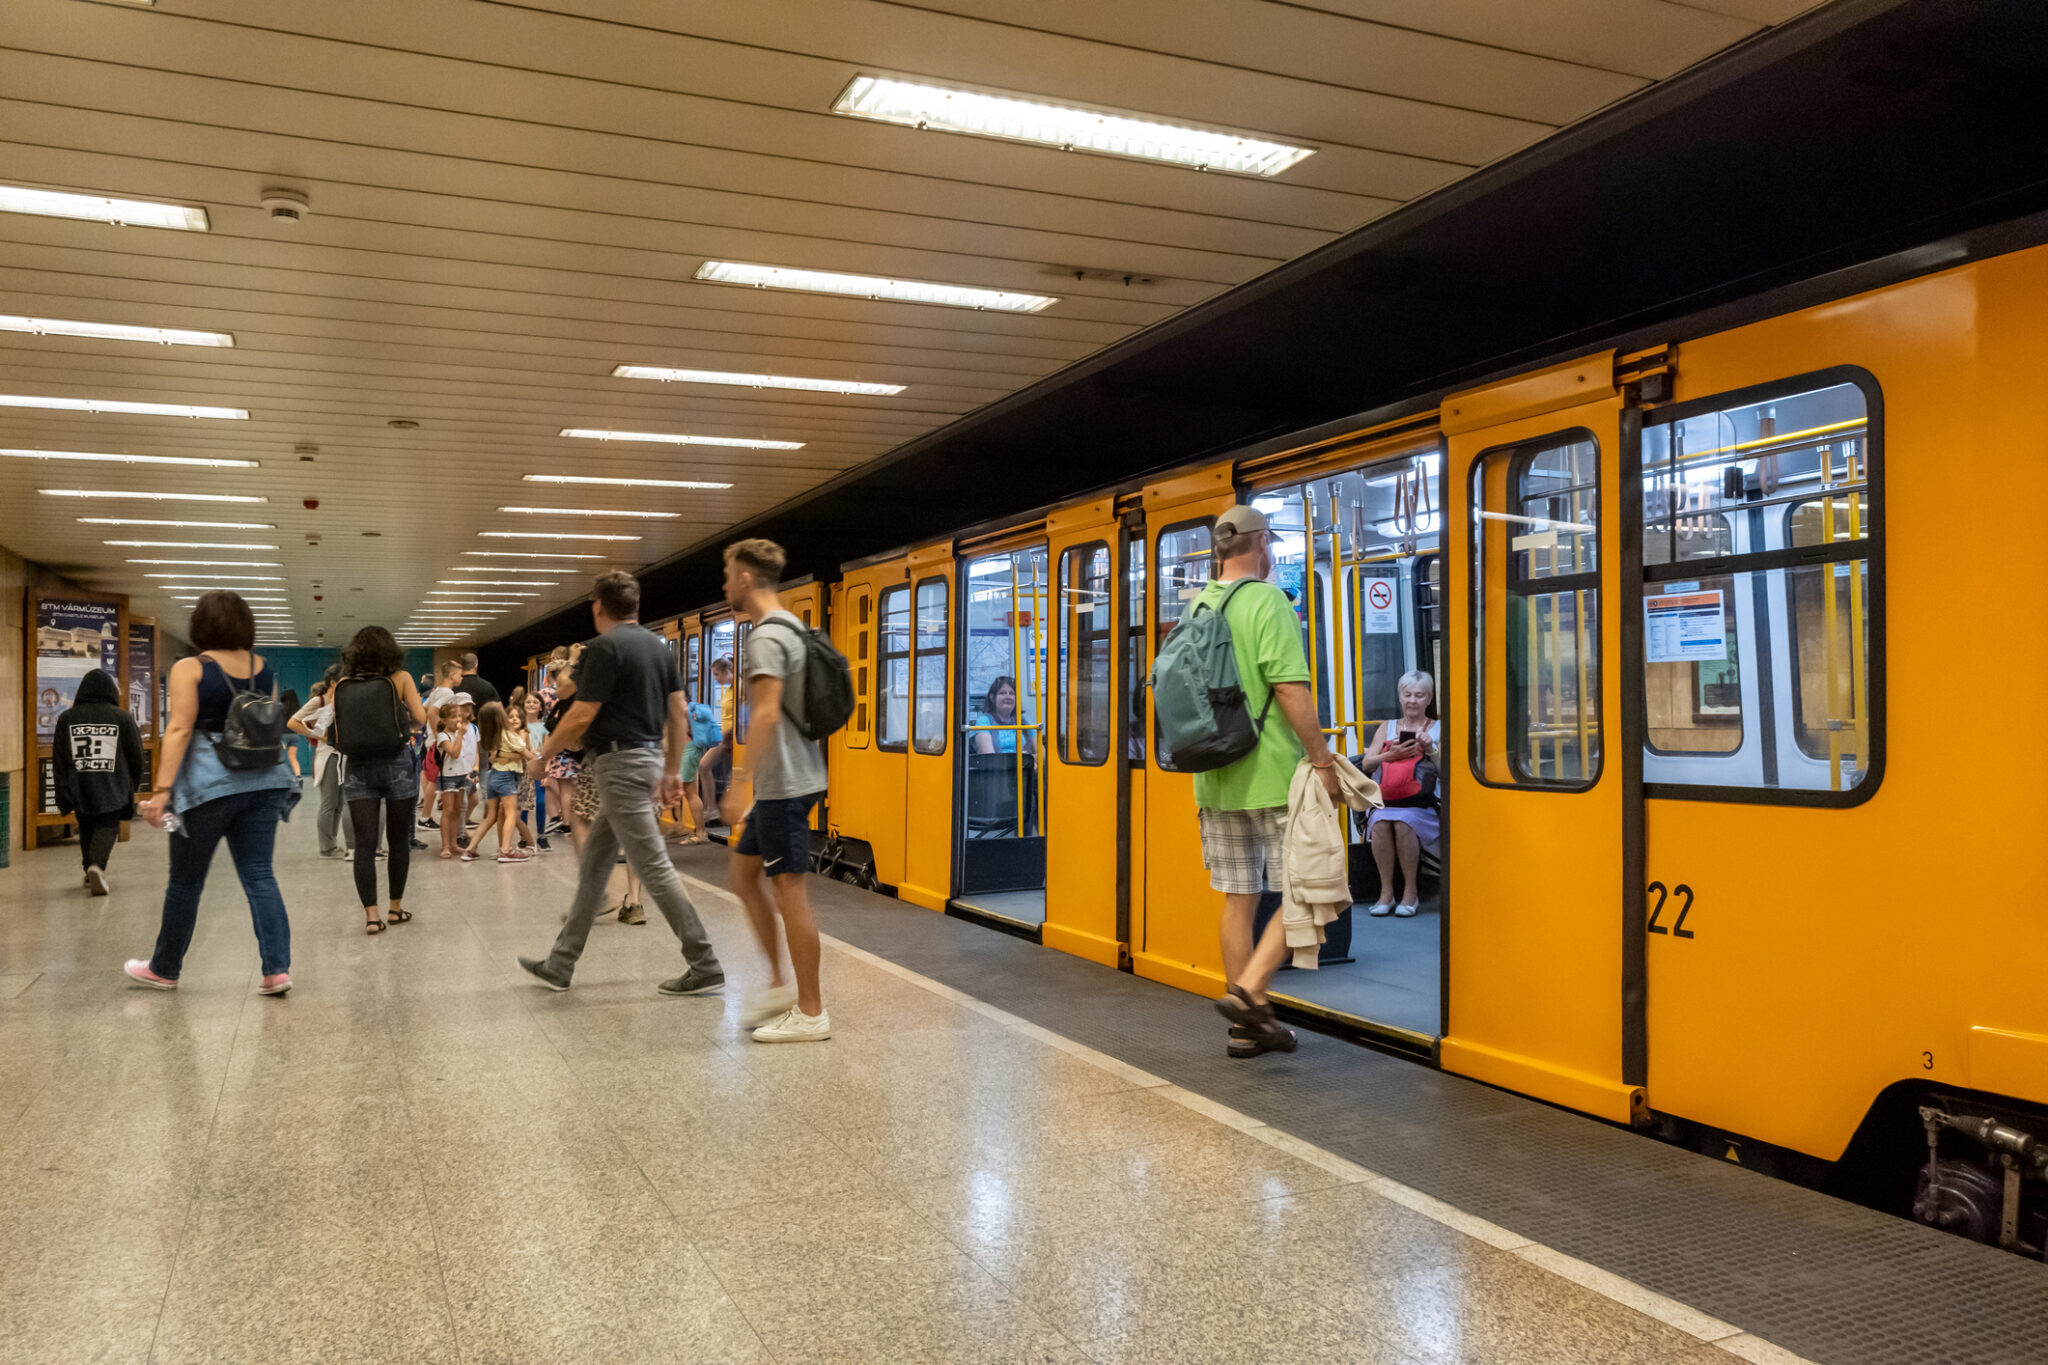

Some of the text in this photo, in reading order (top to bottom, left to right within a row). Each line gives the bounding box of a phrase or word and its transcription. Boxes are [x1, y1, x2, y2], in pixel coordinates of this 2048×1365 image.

[61, 602, 116, 614] VÁRMÚZEUM
[1648, 881, 1694, 939] 22
[1922, 1050, 1934, 1070] 3
